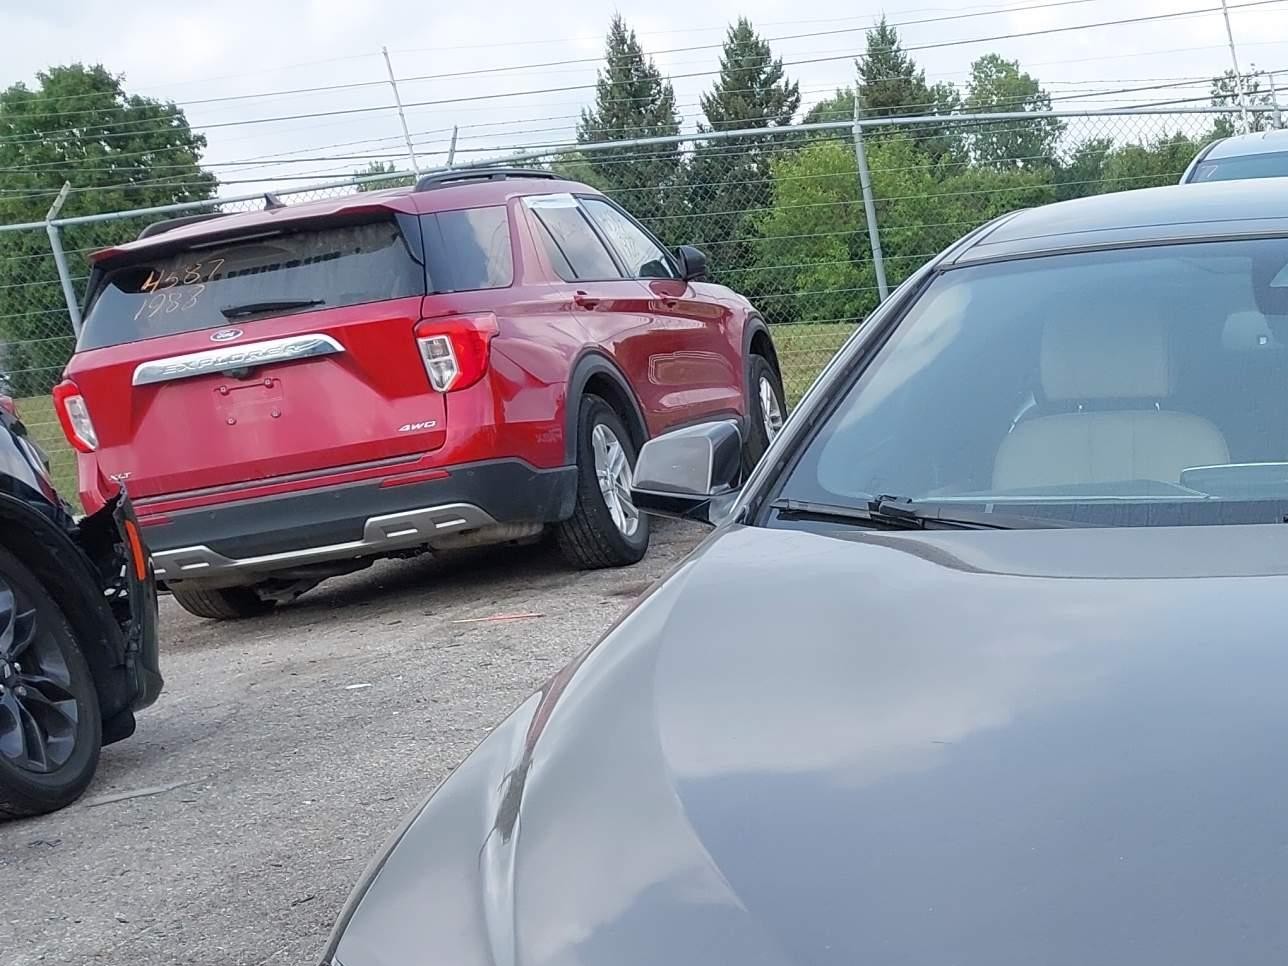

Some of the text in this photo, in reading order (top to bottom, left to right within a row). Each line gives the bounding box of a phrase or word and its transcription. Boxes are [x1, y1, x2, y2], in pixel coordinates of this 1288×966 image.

[140, 259, 224, 294] 4587
[134, 284, 205, 320] 1983
[162, 342, 301, 375] EXPLORER
[398, 420, 436, 431] 4WD
